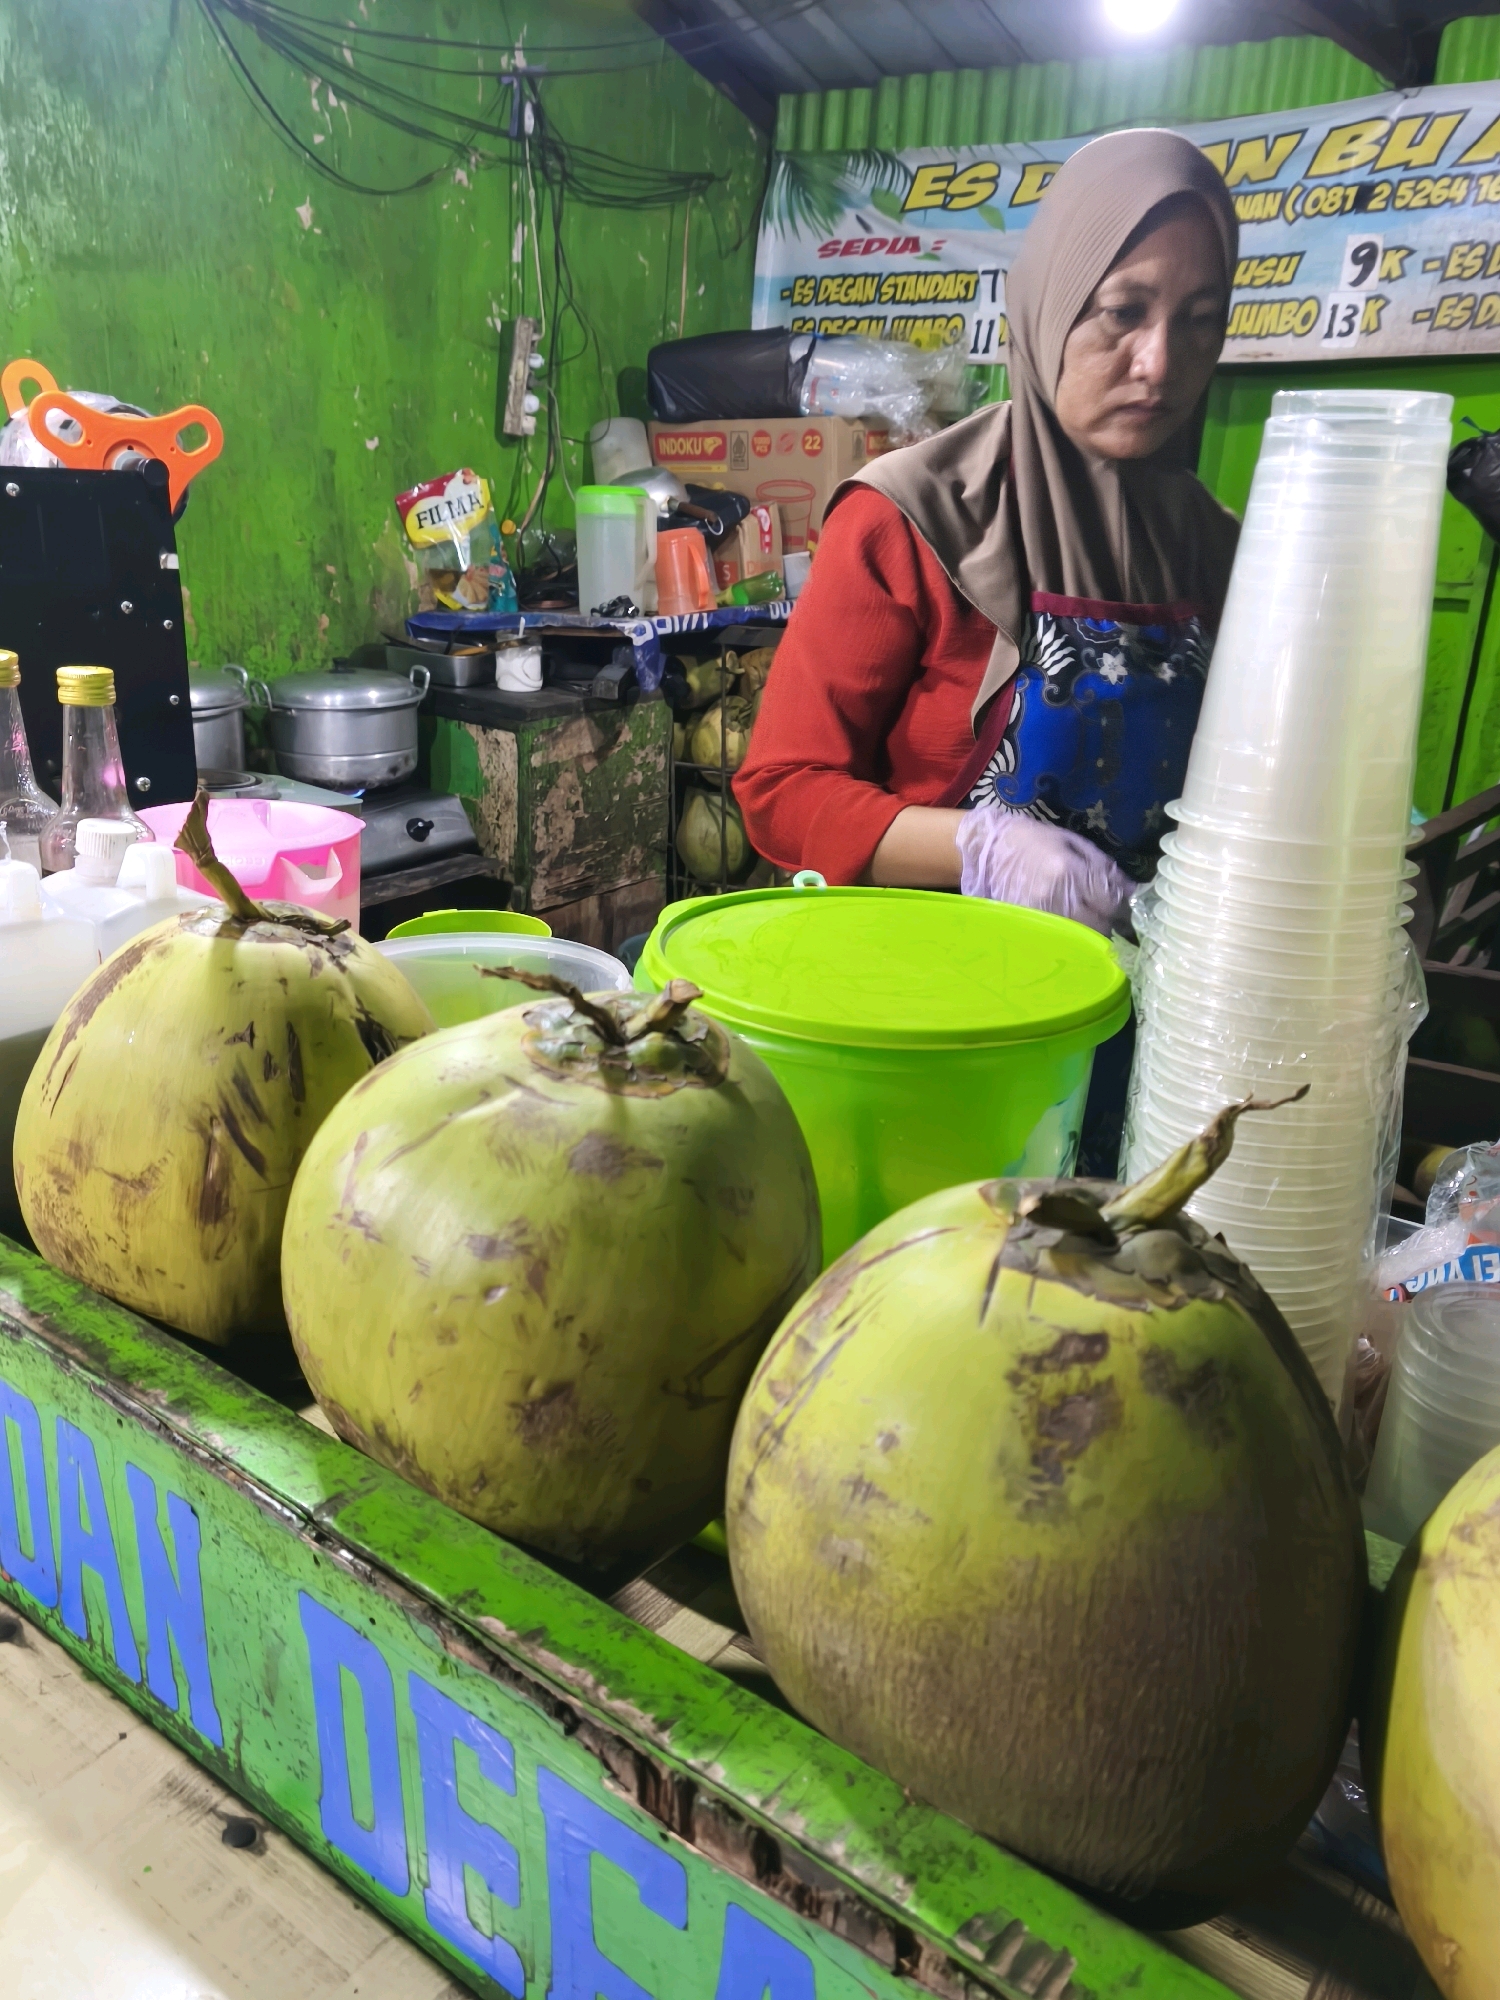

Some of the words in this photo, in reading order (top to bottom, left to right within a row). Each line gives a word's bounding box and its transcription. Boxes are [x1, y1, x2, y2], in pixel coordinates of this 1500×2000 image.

[900, 161, 1001, 213] ES
[1302, 107, 1472, 180] BU
[815, 273, 883, 307] DEGAN
[878, 270, 979, 306] STANDART
[1225, 296, 1321, 340] JUMBO
[658, 437, 702, 456] INDOKU
[804, 435, 821, 451] 22
[415, 491, 485, 530] FILMA
[0, 1377, 223, 1749] DAN
